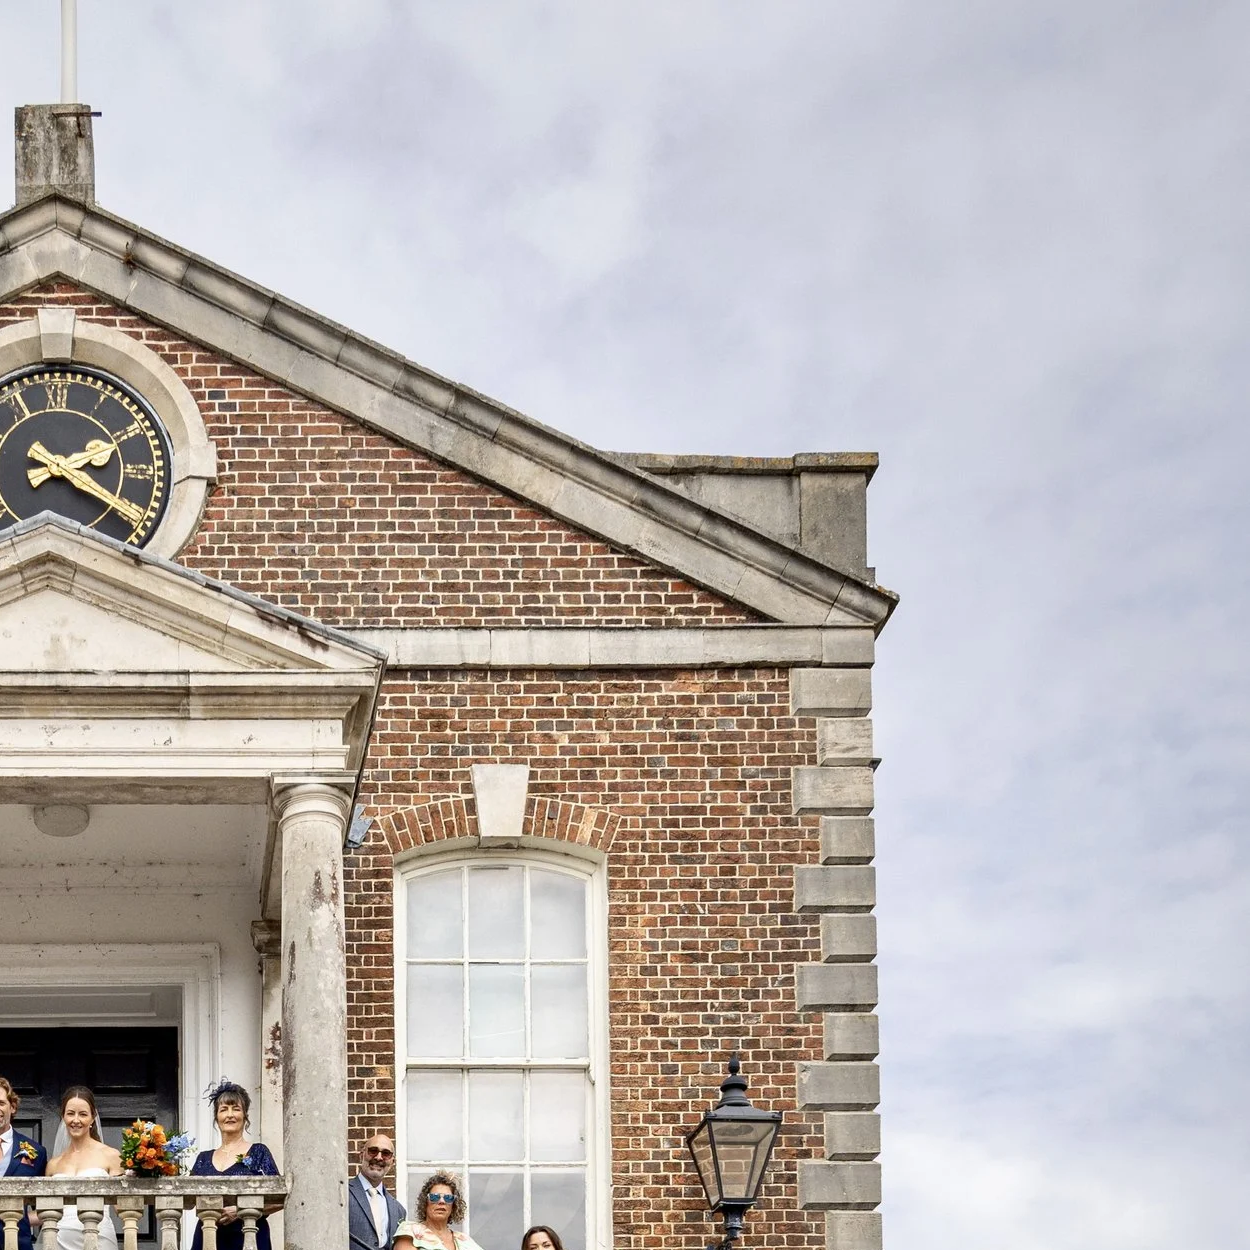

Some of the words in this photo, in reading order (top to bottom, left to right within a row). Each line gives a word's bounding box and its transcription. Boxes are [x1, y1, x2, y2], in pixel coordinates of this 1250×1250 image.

[45, 382, 71, 409] XII
[113, 421, 144, 443] II
[125, 464, 153, 481] III
